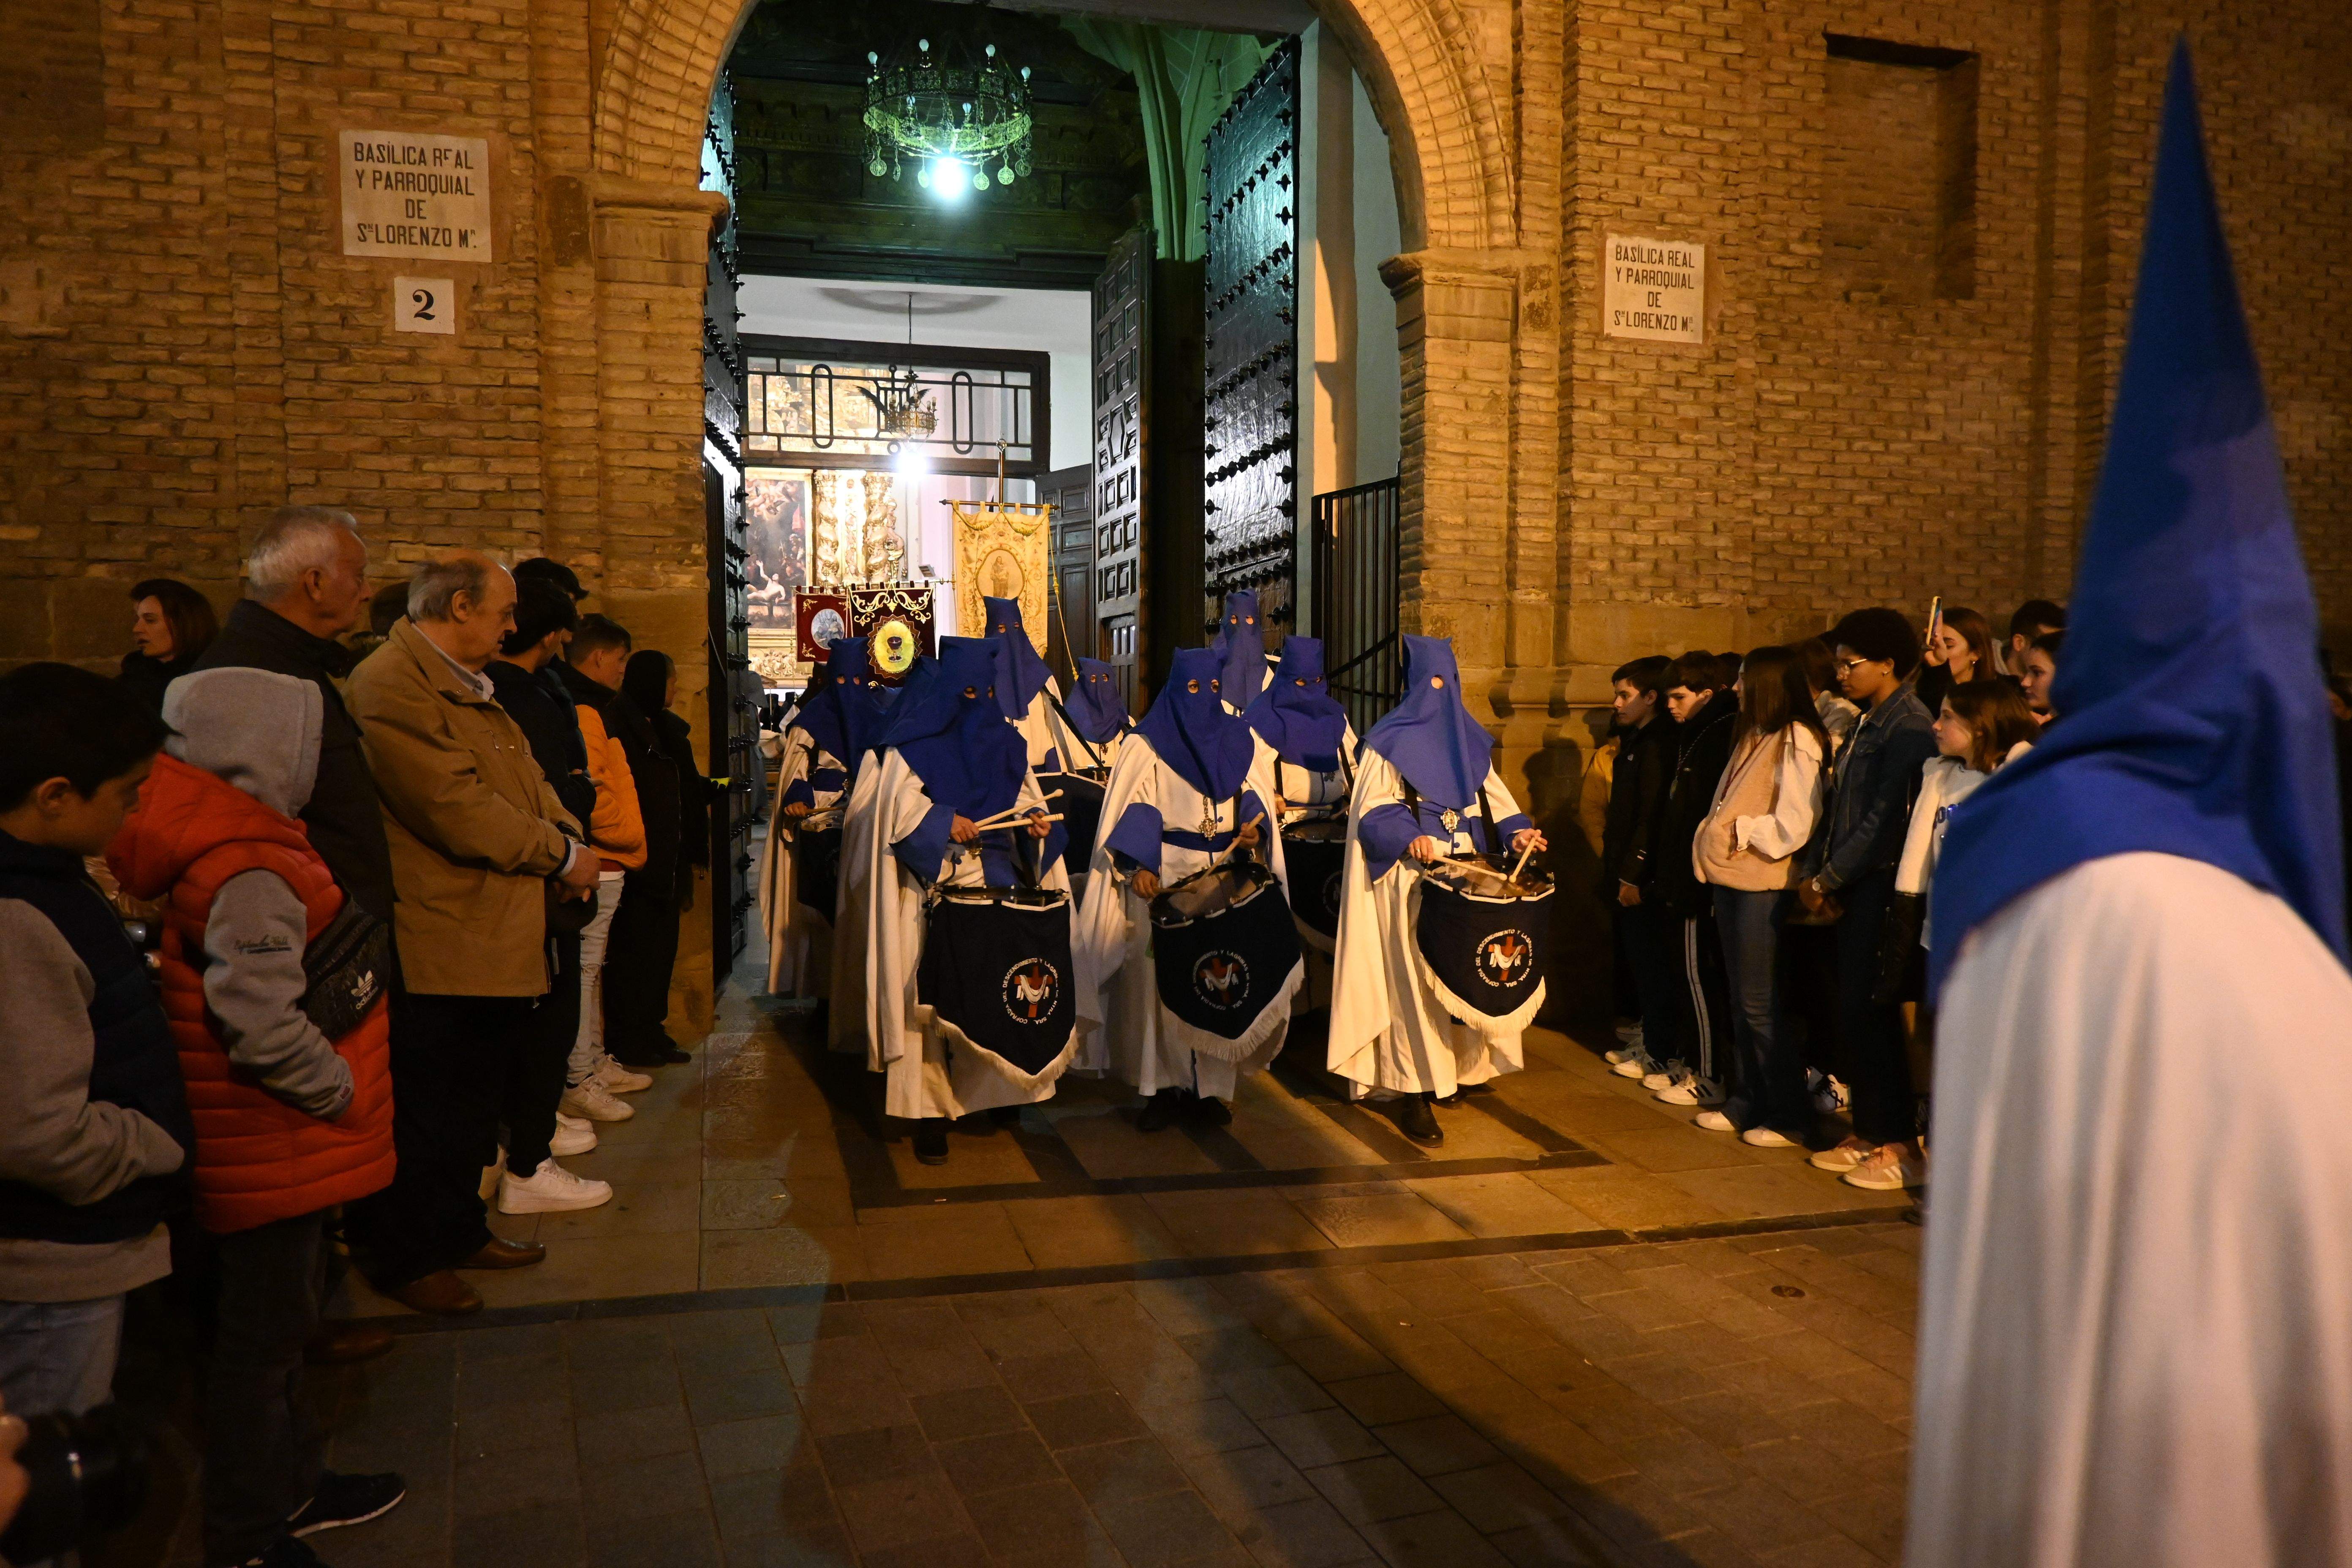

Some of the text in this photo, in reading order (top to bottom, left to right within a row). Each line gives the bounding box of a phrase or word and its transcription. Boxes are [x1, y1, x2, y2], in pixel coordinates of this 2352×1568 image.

[433, 148, 474, 169] REAL
[355, 169, 475, 196] Y PARROQUIAL
[406, 199, 427, 220] DE
[375, 224, 452, 247] LORENZO
[1668, 250, 1695, 268] REAL
[1616, 266, 1694, 290] Y PARROQUIAL
[412, 289, 436, 320] 2
[1648, 291, 1662, 308] DE
[1626, 311, 1677, 331] LORENZO
[1478, 968, 1499, 987] COFRADIA
[356, 986, 379, 1010] adidas
[1005, 1004, 1028, 1024] COFRADIA
